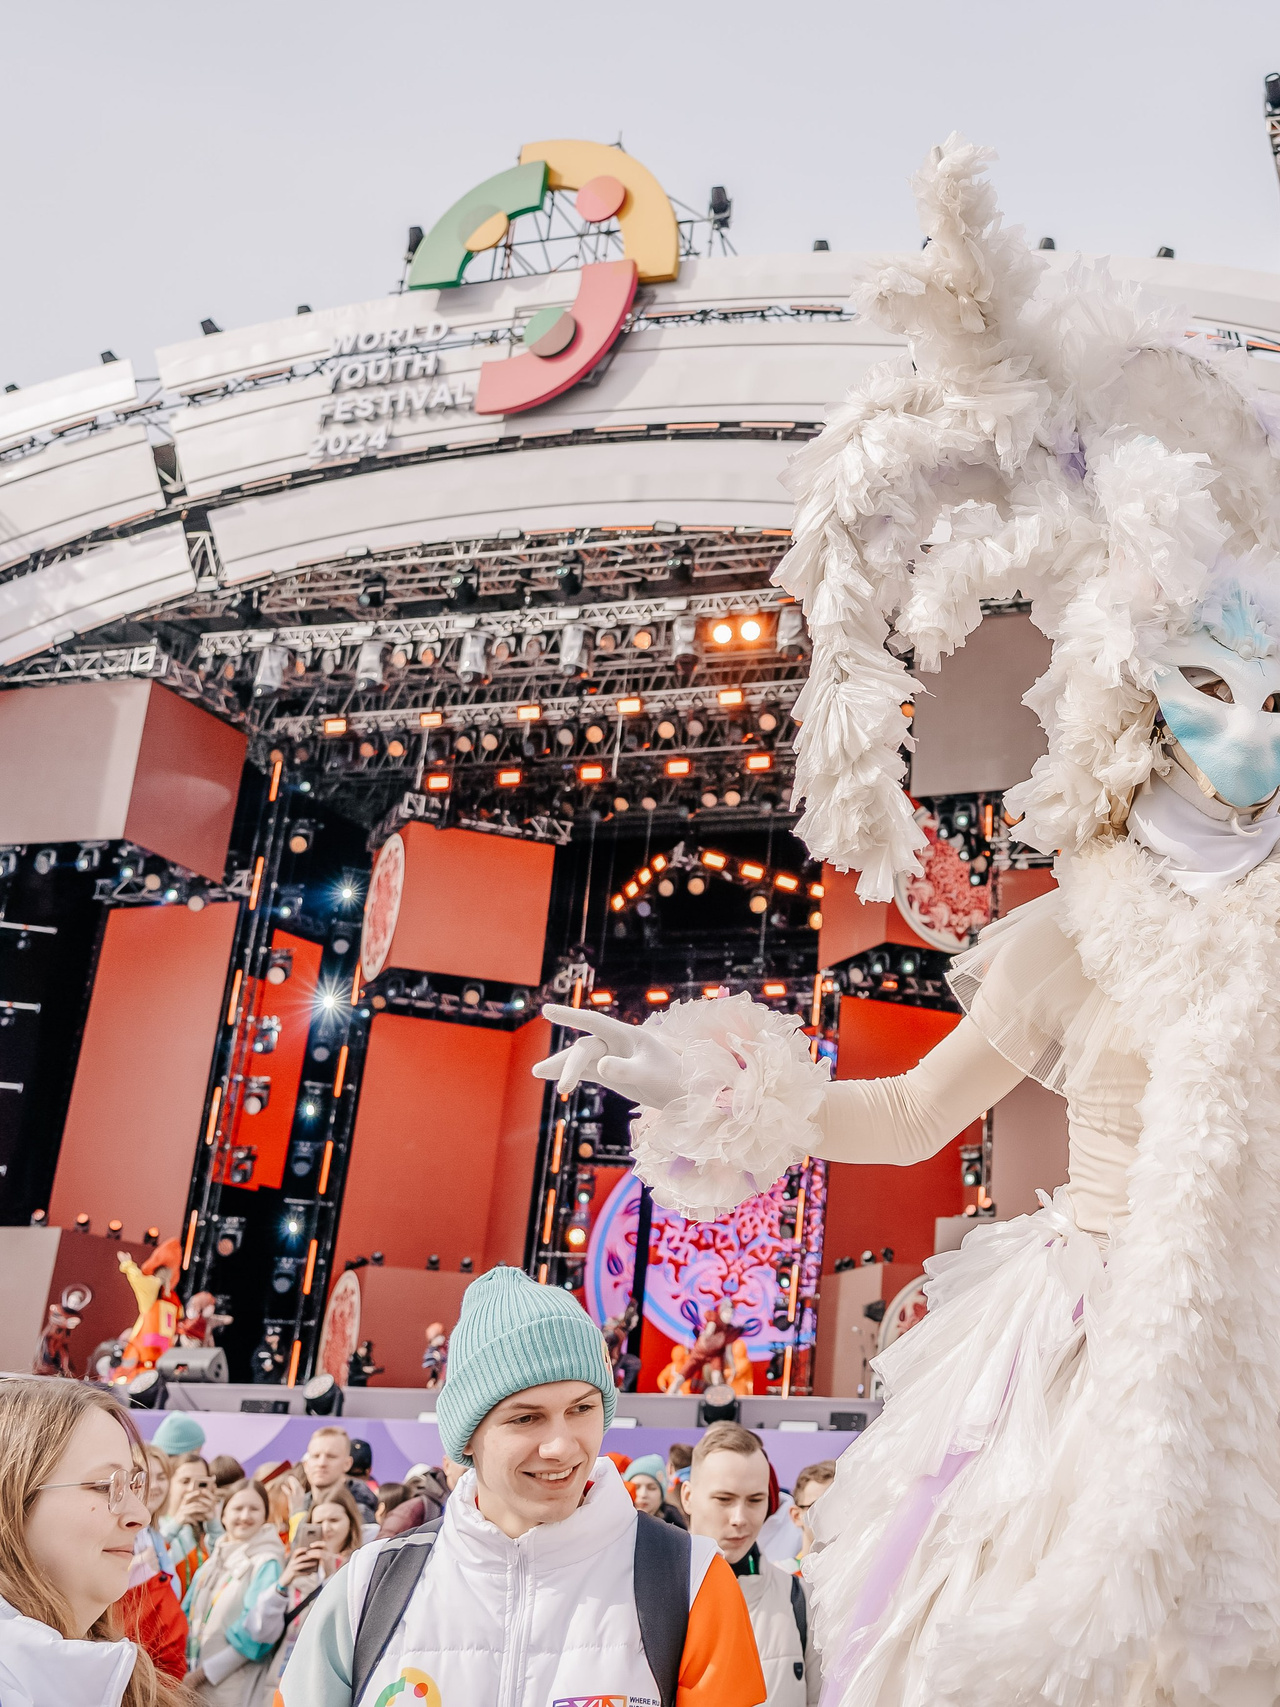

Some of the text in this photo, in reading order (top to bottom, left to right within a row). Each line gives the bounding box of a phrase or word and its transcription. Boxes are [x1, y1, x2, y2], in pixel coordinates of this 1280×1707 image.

[331, 319, 450, 355] WORLD
[323, 351, 440, 391] YOUTH
[319, 382, 474, 424] FESTIVAL
[308, 424, 389, 459] 2024
[629, 1696, 651, 1705] WHERE
